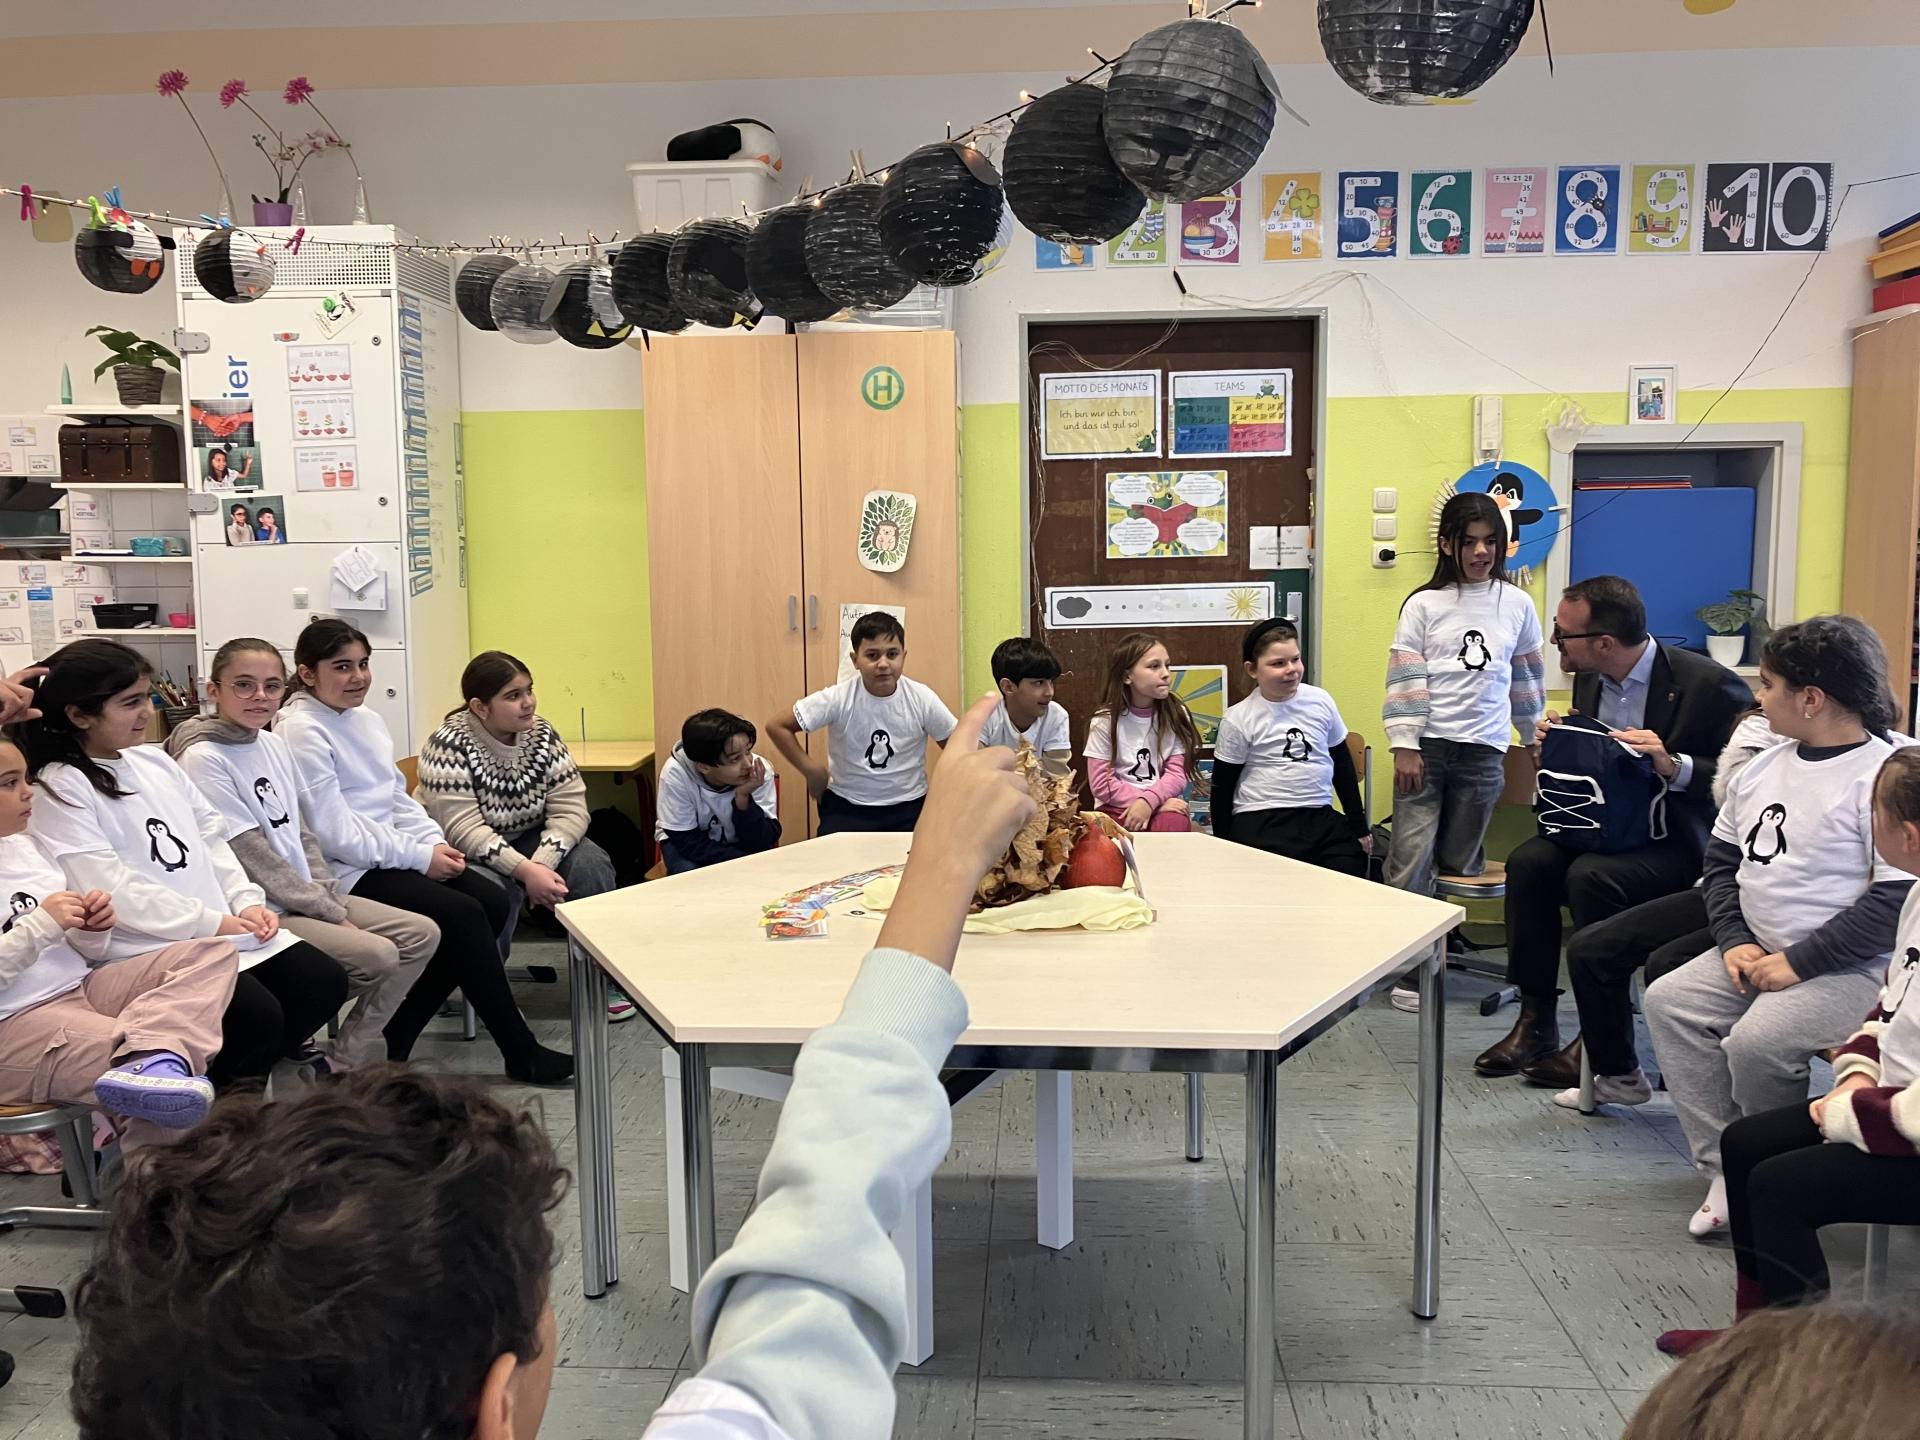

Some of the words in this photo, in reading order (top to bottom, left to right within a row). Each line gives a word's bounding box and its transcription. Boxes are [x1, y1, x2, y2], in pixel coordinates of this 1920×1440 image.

[1266, 180, 1315, 255] 4
[1341, 177, 1381, 252] 5
[1417, 175, 1461, 252] 6
[1493, 174, 1537, 250] 7
[1565, 171, 1607, 249] 8
[1646, 170, 1689, 247] 9
[1723, 166, 1826, 247] 10
[873, 375, 892, 400] H
[1055, 384, 1087, 393] MOTTO
[1090, 383, 1108, 392] DES
[1111, 382, 1147, 392] MONATS
[1060, 410, 1071, 418] Ich
[1075, 409, 1087, 418] bin
[1123, 408, 1136, 416] bin
[1215, 382, 1245, 391] TEAMS
[1064, 421, 1079, 430] und
[1083, 421, 1097, 429] das
[1100, 421, 1109, 429] ist
[1112, 421, 1125, 431] gut
